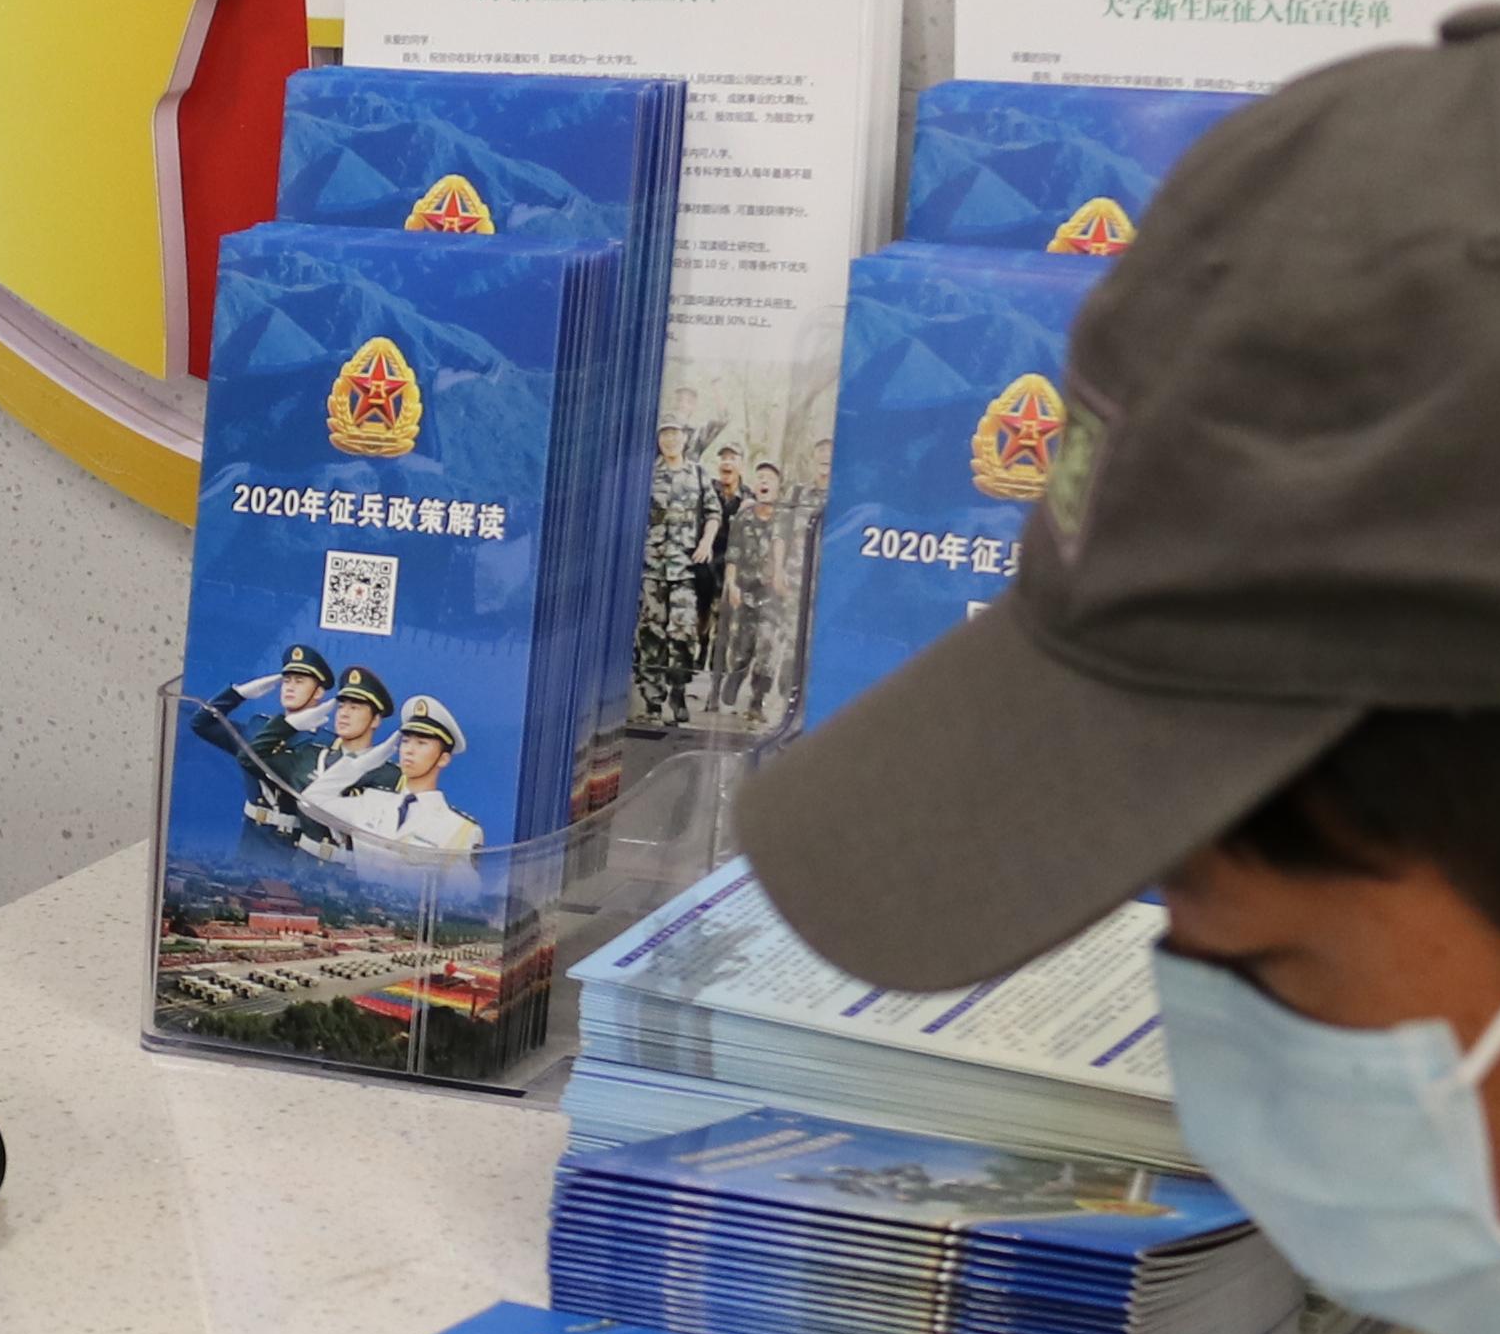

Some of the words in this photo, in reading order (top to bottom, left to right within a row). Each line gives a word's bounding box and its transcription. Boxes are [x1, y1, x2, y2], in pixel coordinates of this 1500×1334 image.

[232, 483, 507, 541] 2020年征兵政策解读
